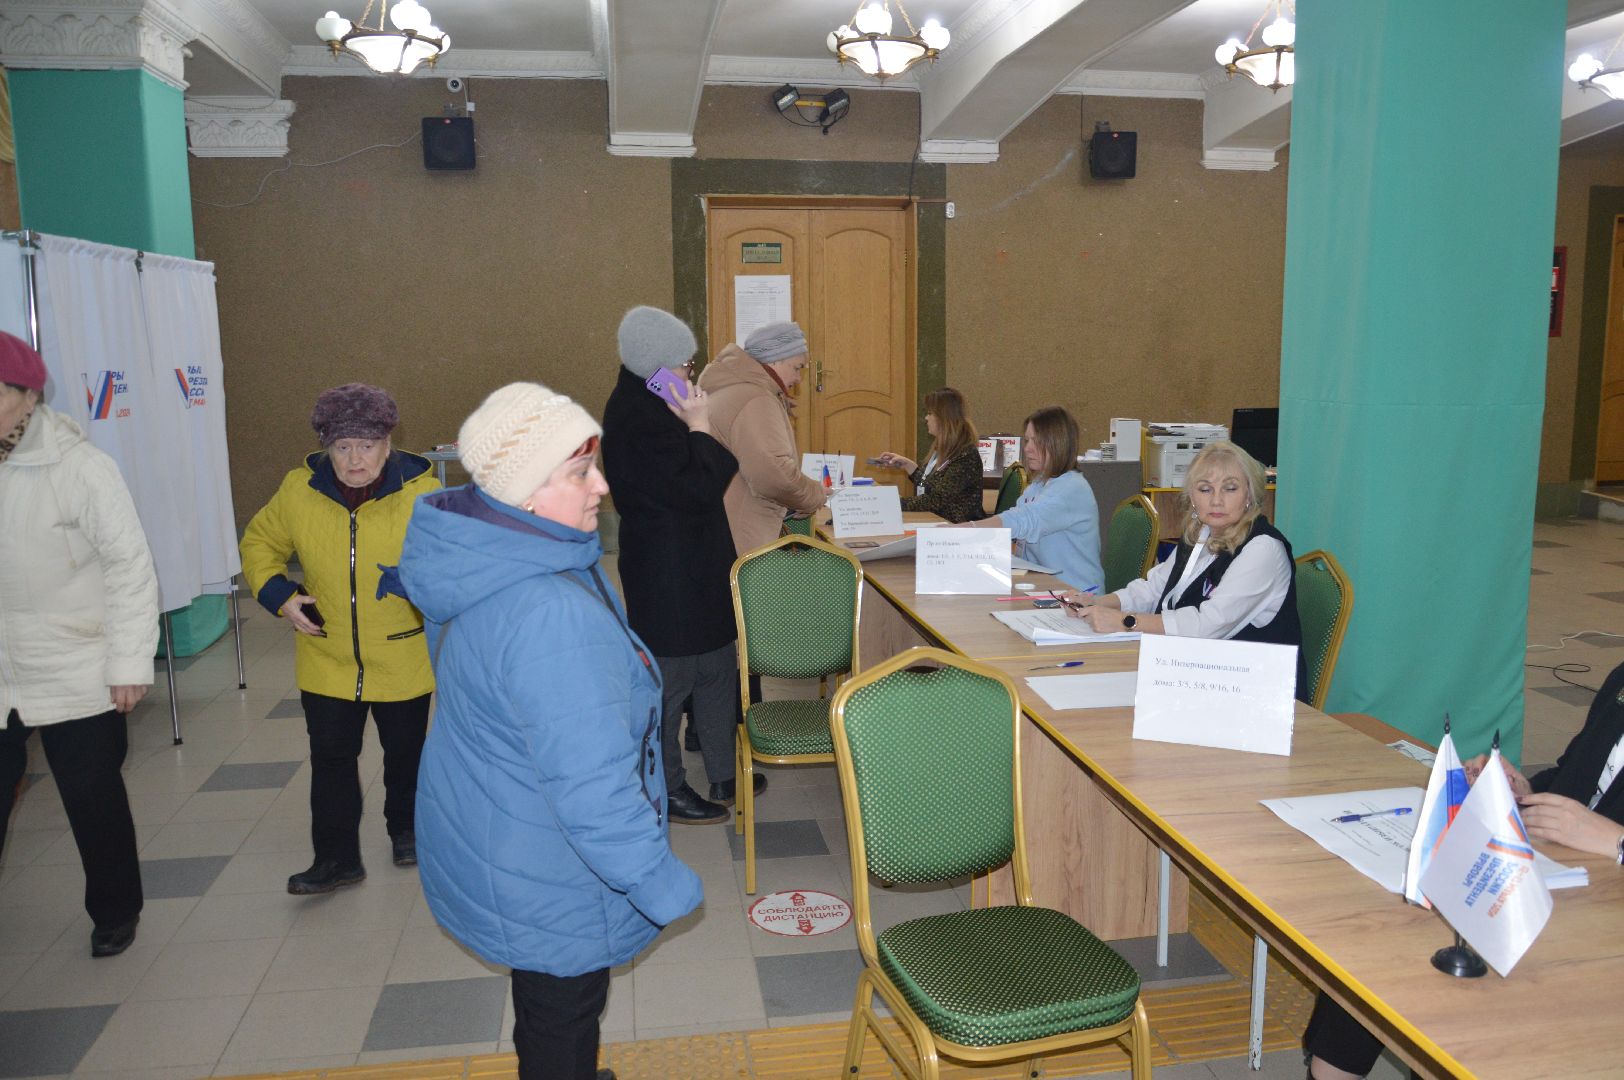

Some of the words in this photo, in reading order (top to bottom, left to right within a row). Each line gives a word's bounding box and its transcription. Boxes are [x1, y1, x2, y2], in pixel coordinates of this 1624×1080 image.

[1155, 656, 1168, 666] Ул.
[1170, 658, 1251, 673] Интернациональная
[1152, 679, 1175, 687] дома:
[757, 904, 847, 915] СОБЛЮДАЙТЕ
[763, 911, 844, 922] ДИСТАНЦИЮ
